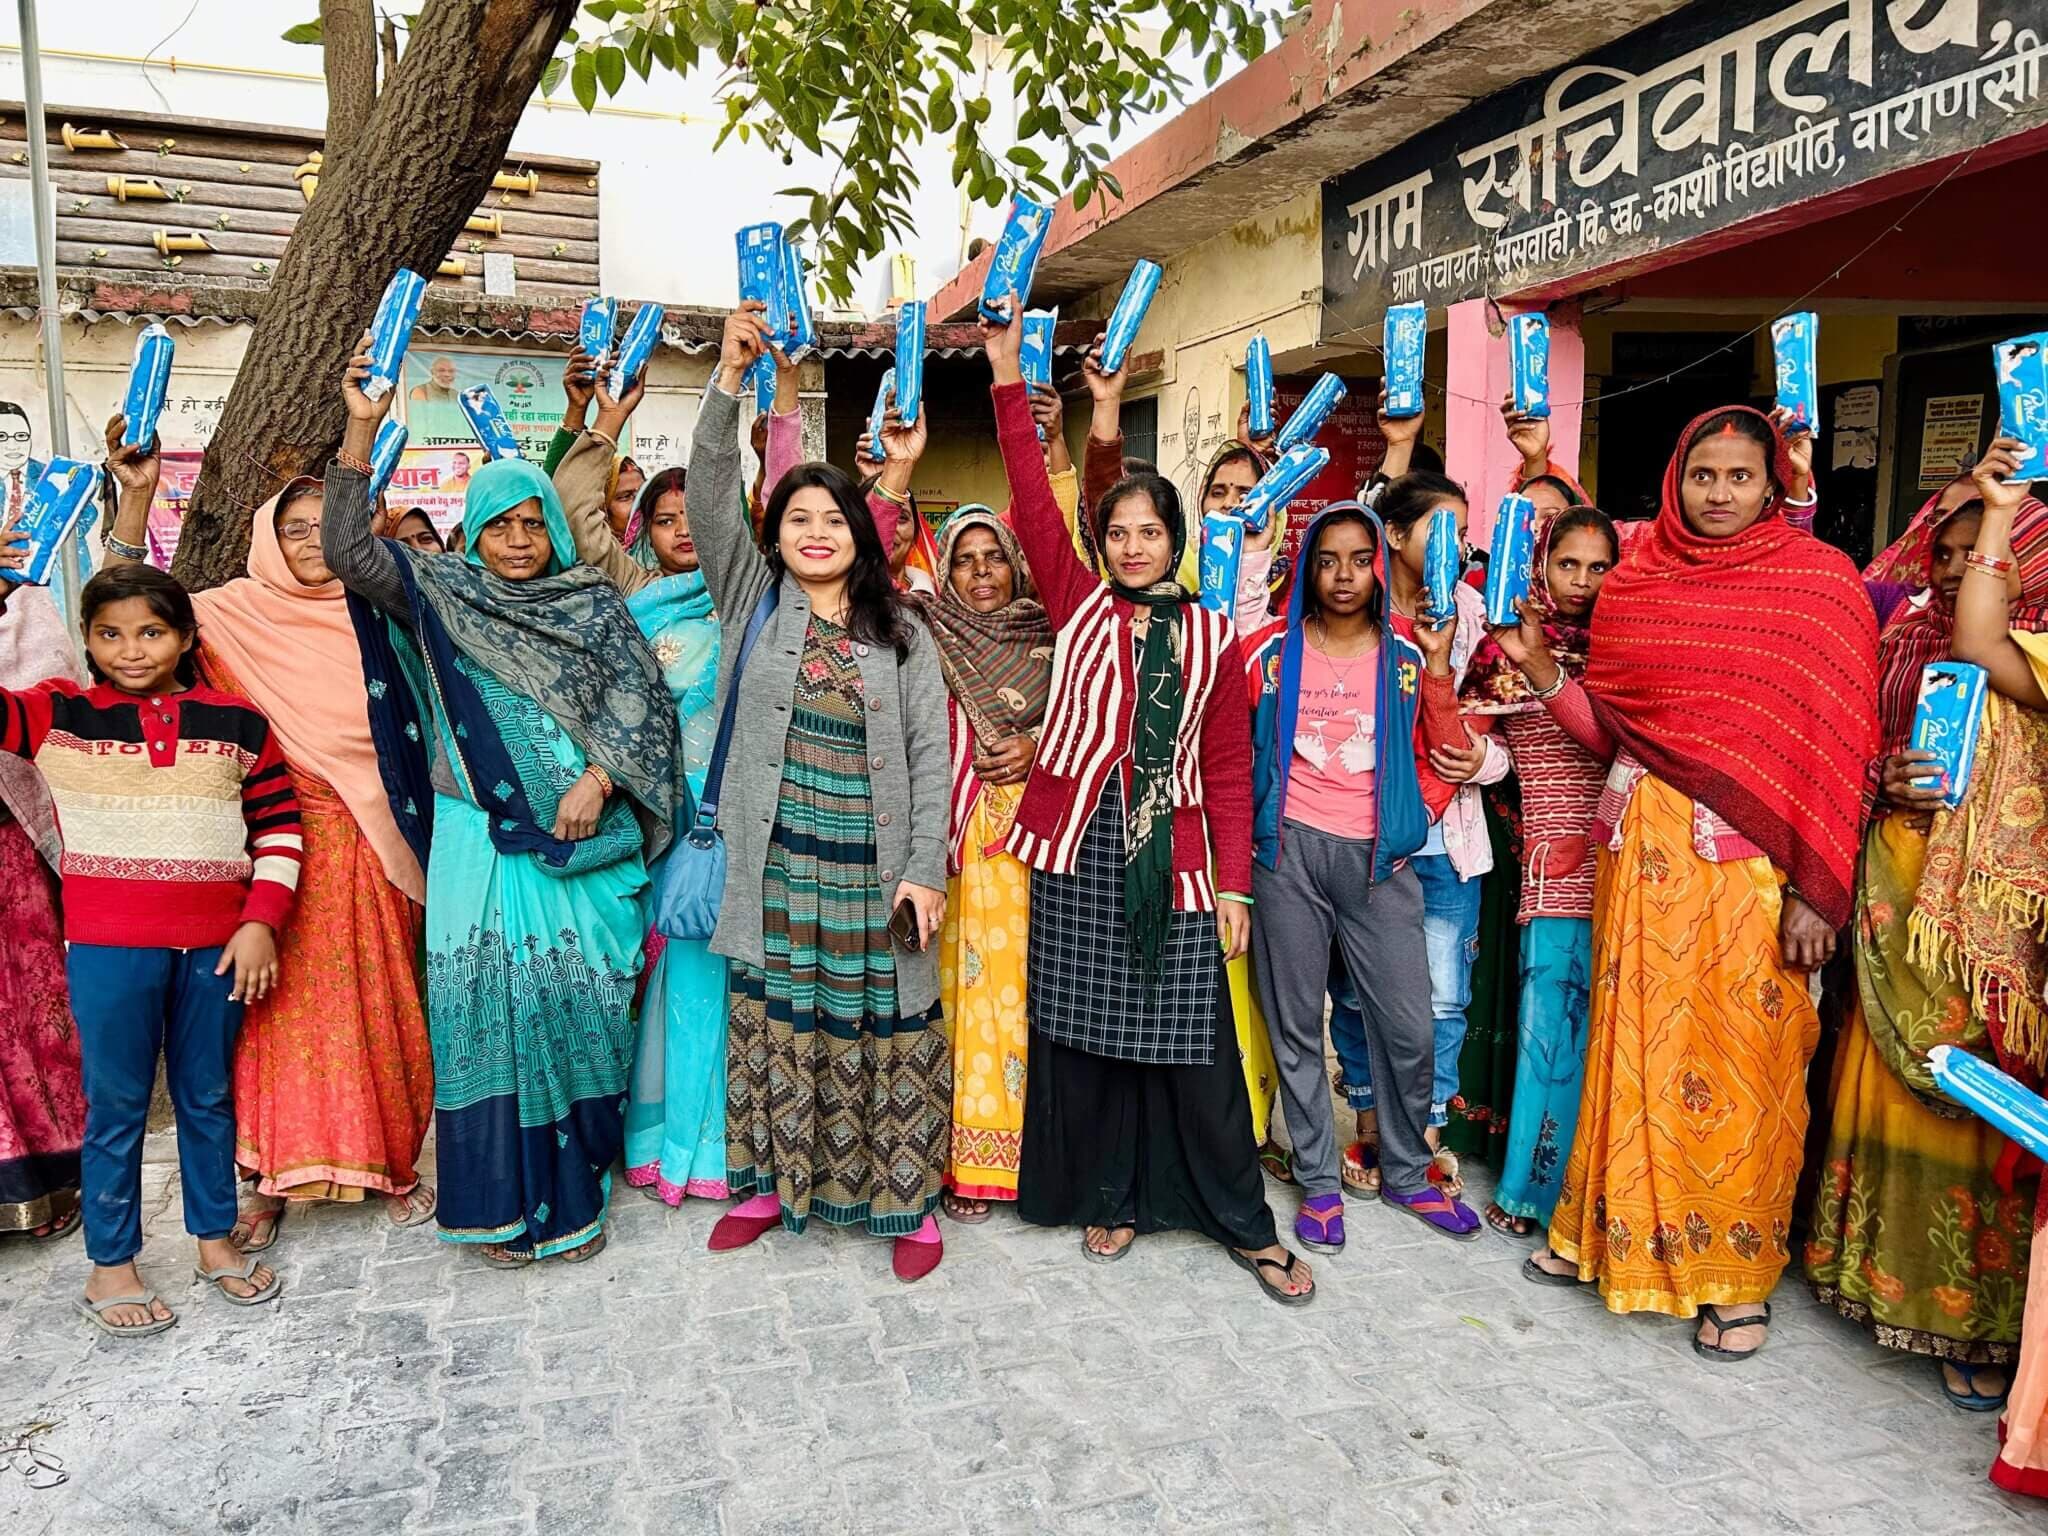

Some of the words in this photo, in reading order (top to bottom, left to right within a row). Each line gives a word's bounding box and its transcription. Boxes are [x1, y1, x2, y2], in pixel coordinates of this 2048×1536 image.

[1392, 263, 1418, 301] ग्राम
[1849, 28, 2048, 153] वाराणसी
[1347, 169, 1433, 281] ग्राम
[97, 740, 237, 758] TOER
